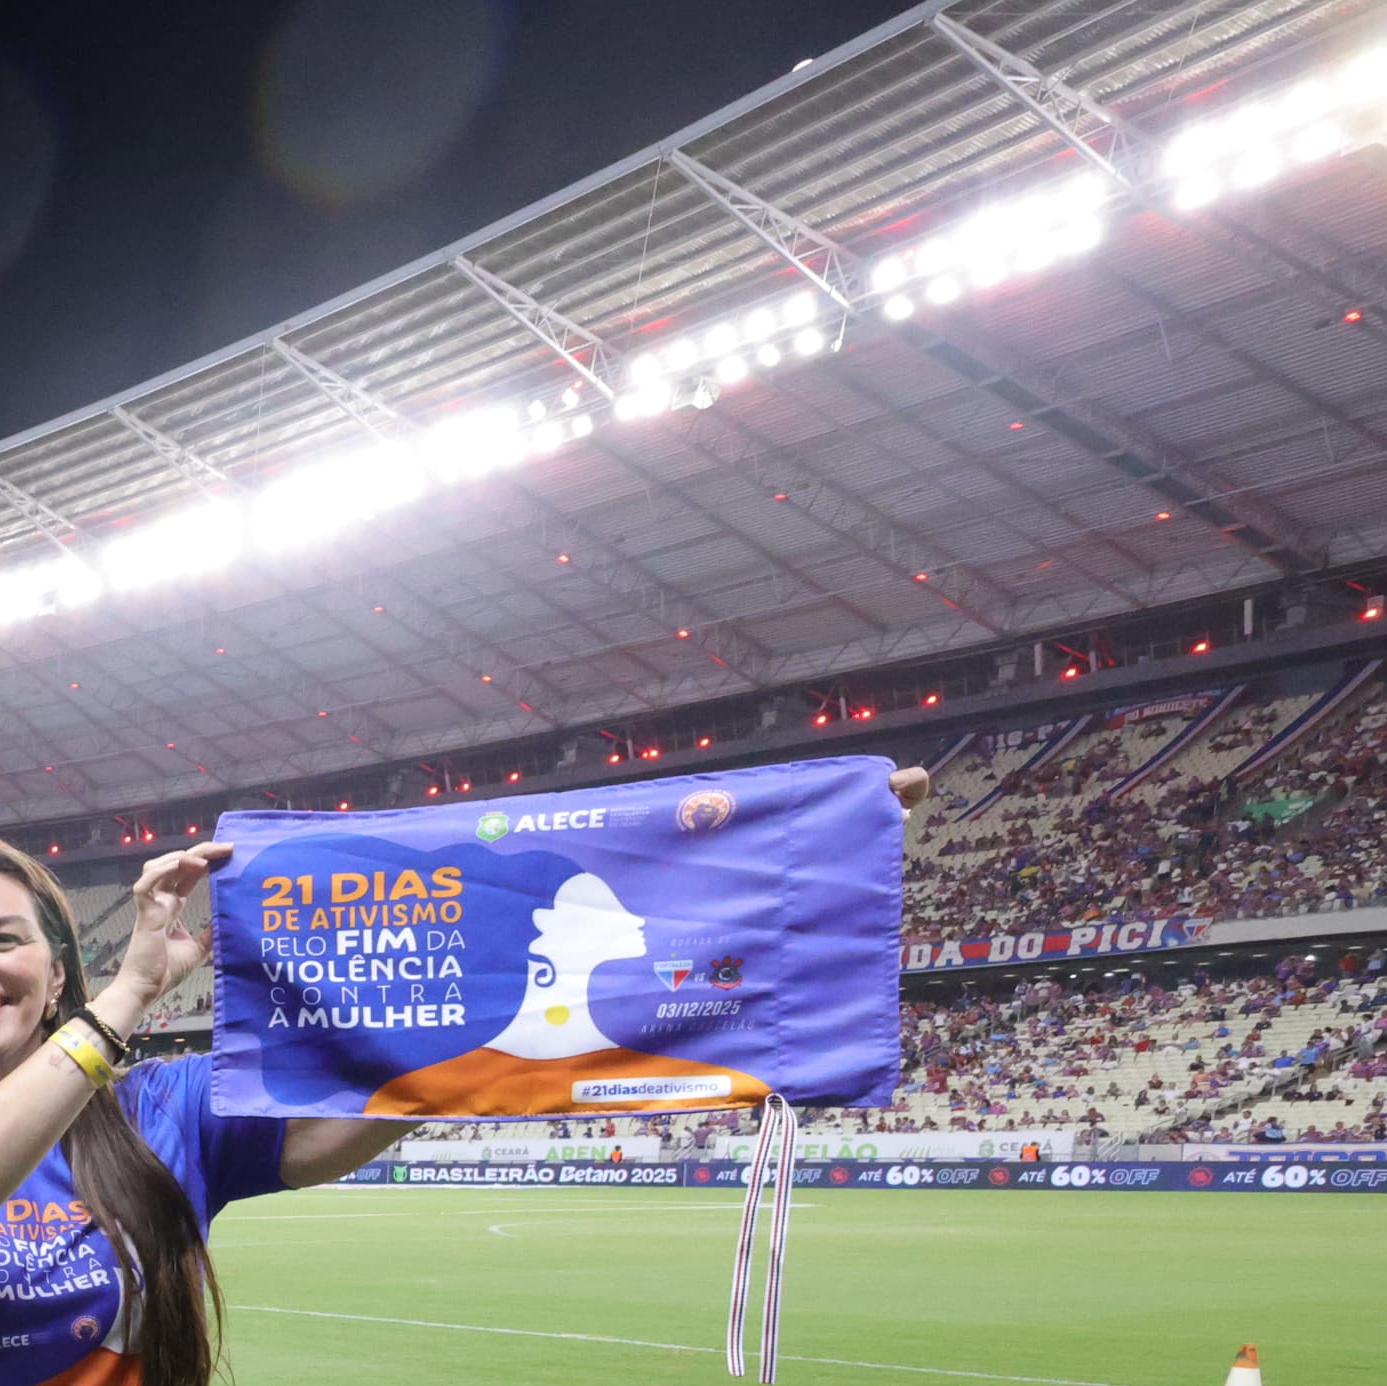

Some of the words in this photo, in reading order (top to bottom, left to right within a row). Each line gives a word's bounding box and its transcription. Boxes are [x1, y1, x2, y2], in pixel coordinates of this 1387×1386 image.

[514, 808, 607, 833] ALECE
[261, 875, 313, 907] 21
[331, 866, 463, 903] DIAS
[263, 909, 300, 931] DE
[311, 900, 462, 930] ATIVISMO
[261, 936, 326, 957] PELO
[336, 928, 417, 955] FIM
[427, 929, 465, 950] DA
[988, 931, 1045, 961] DO
[1066, 919, 1166, 956] PICI
[262, 954, 463, 983] VIOLÊNCIA
[271, 983, 462, 1005] CONTRA
[268, 1007, 289, 1029] A
[298, 1004, 465, 1029] MULHER
[657, 1001, 742, 1018] 03/12/2025
[582, 1082, 718, 1097] #21diasdeativismo
[410, 1164, 553, 1182] BRASILEIRÃO
[558, 1166, 627, 1183] Betano
[632, 1168, 677, 1183] 2025
[716, 1167, 737, 1181] ATÉ
[858, 1169, 882, 1182] ATÉ
[886, 1166, 934, 1185] 60%
[936, 1169, 980, 1184] OFF
[1018, 1169, 1046, 1183] ATÉ
[1051, 1165, 1106, 1187] 60%
[1109, 1169, 1160, 1185] OFF
[1223, 1168, 1256, 1184] ATÉ
[1261, 1165, 1326, 1188] 60%
[1330, 1169, 1387, 1186] OFF
